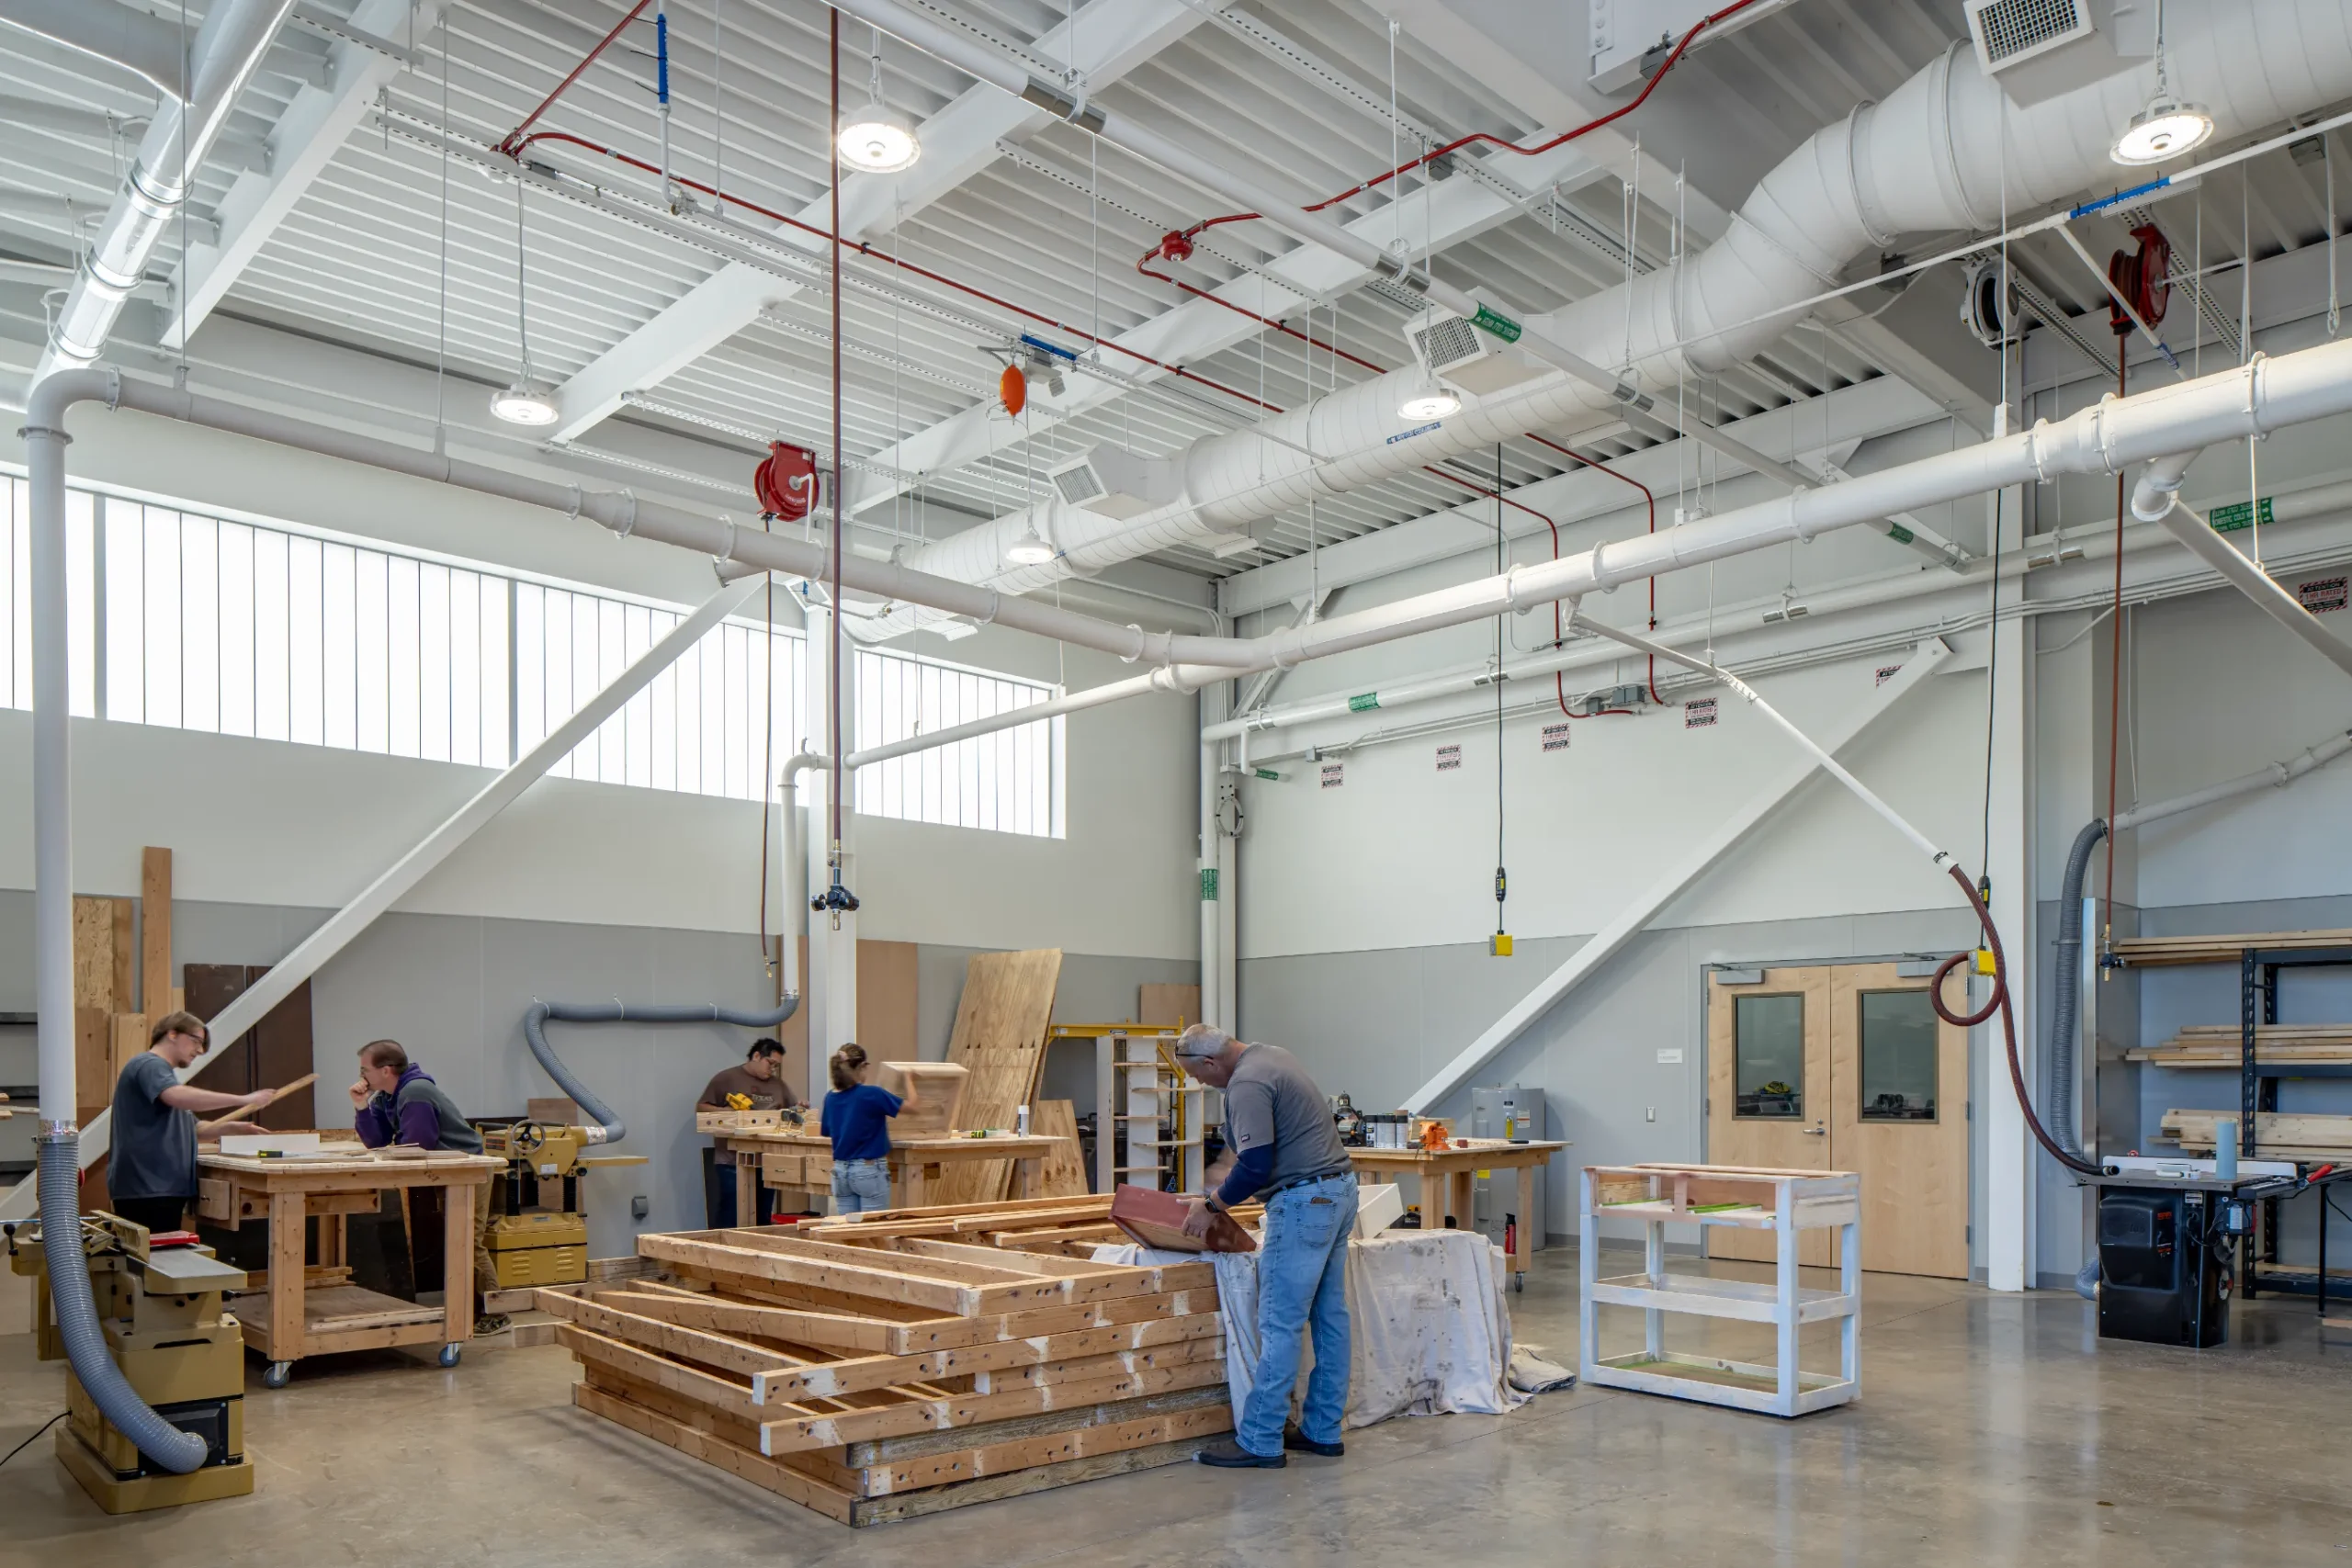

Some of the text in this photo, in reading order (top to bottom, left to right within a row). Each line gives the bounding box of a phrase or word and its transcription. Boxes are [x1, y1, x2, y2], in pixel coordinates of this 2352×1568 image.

[2307, 582, 2340, 592] ATTENTION
[2320, 588, 2342, 597] RATED
[752, 1094, 774, 1102] TEXAS
